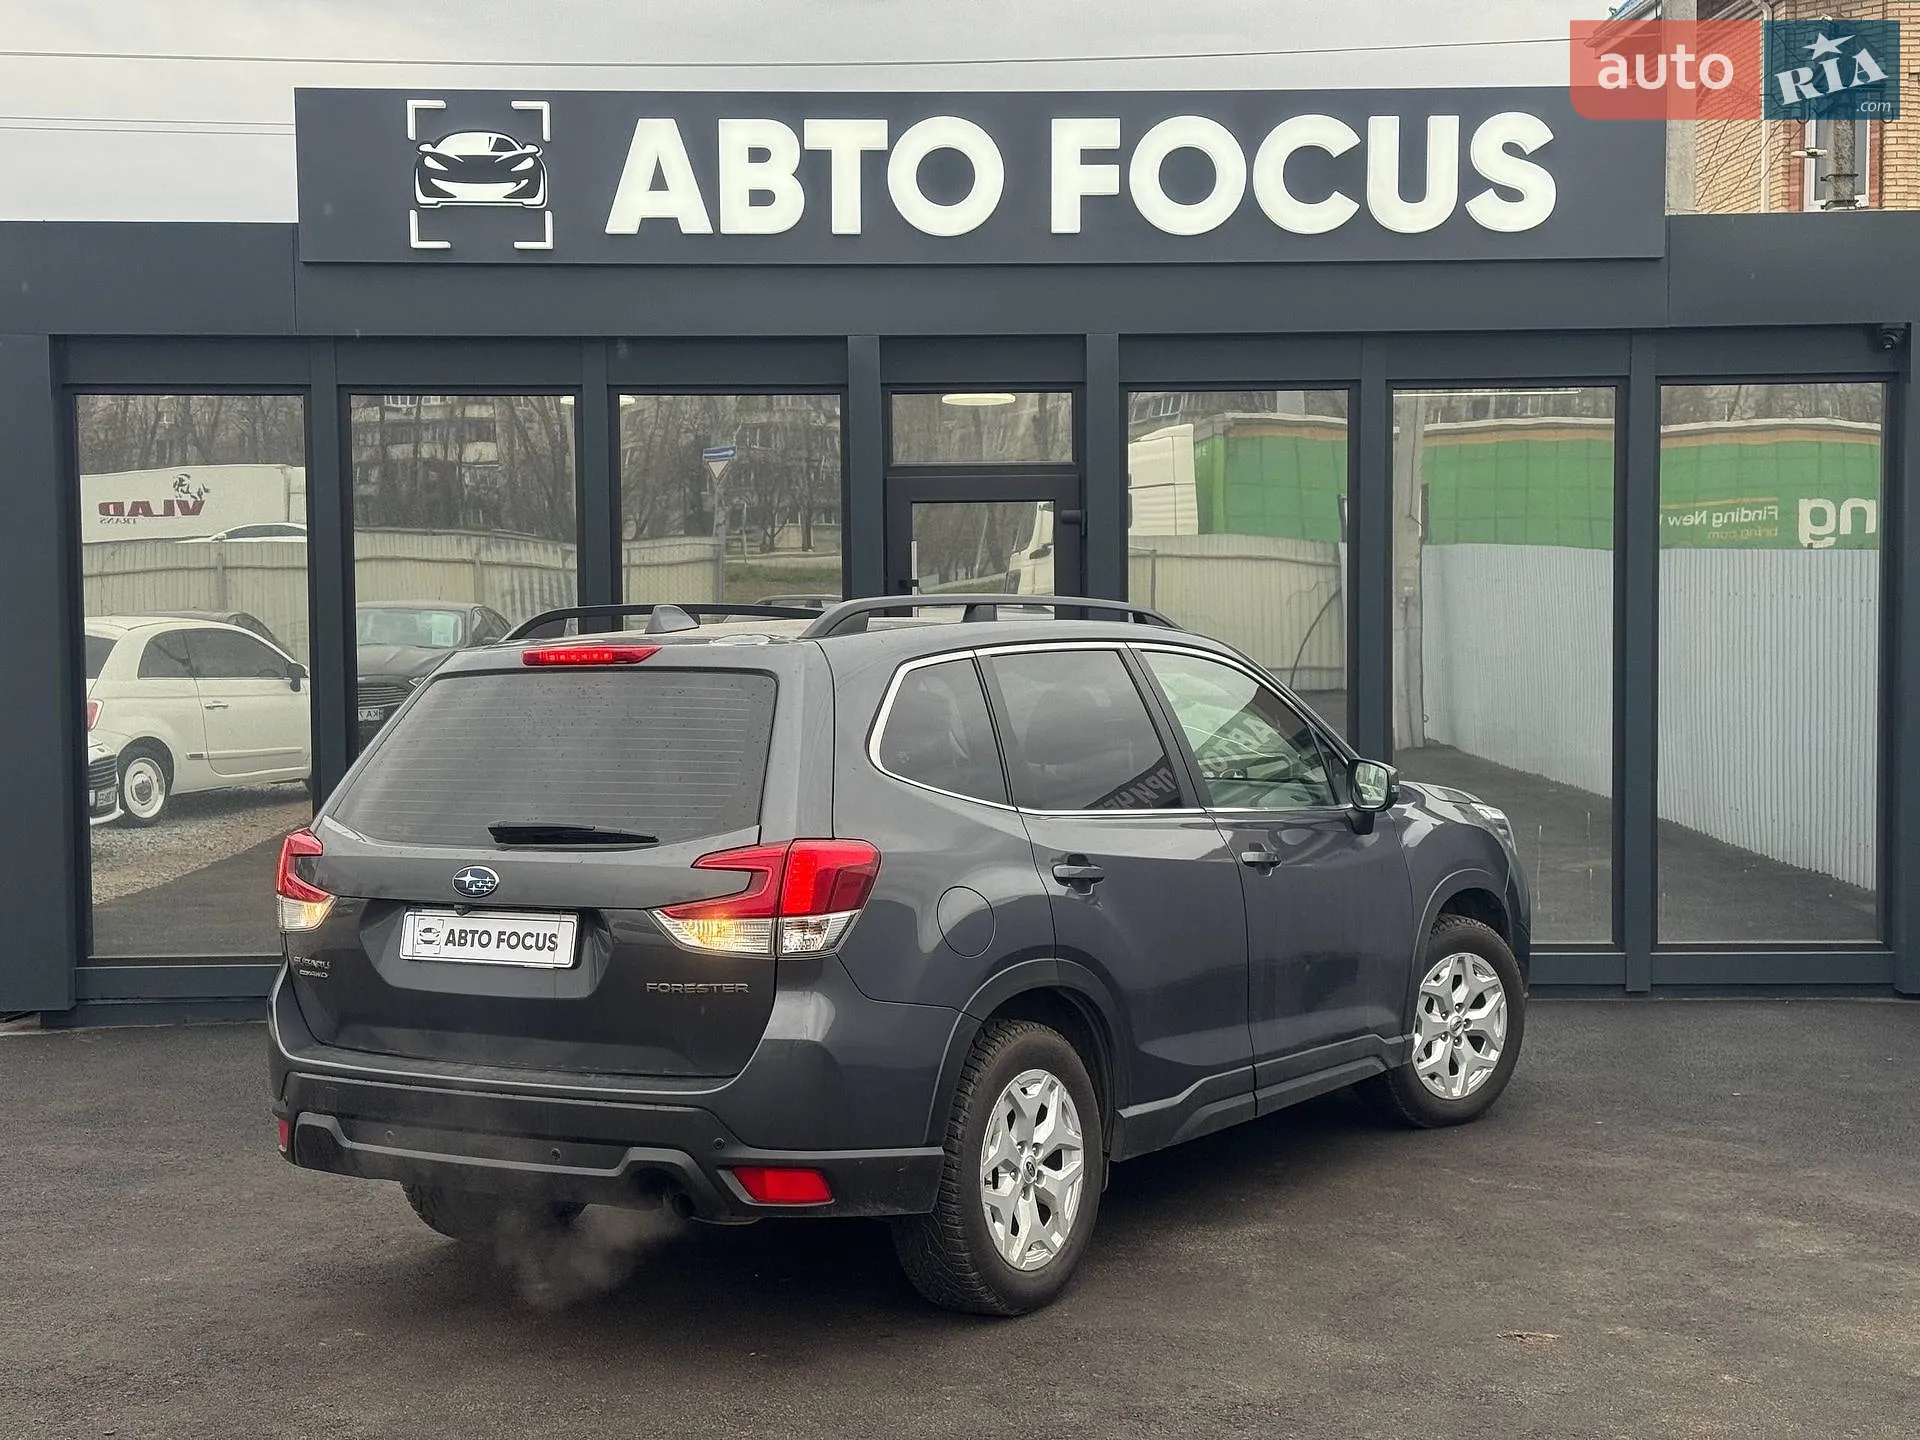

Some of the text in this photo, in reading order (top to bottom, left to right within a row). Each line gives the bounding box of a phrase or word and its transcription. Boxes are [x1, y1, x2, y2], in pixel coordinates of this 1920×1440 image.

[604, 112, 1557, 236] АВТО FOCUS
[444, 928, 559, 952] АВТО FOCUS
[645, 982, 751, 994] FORESTER
